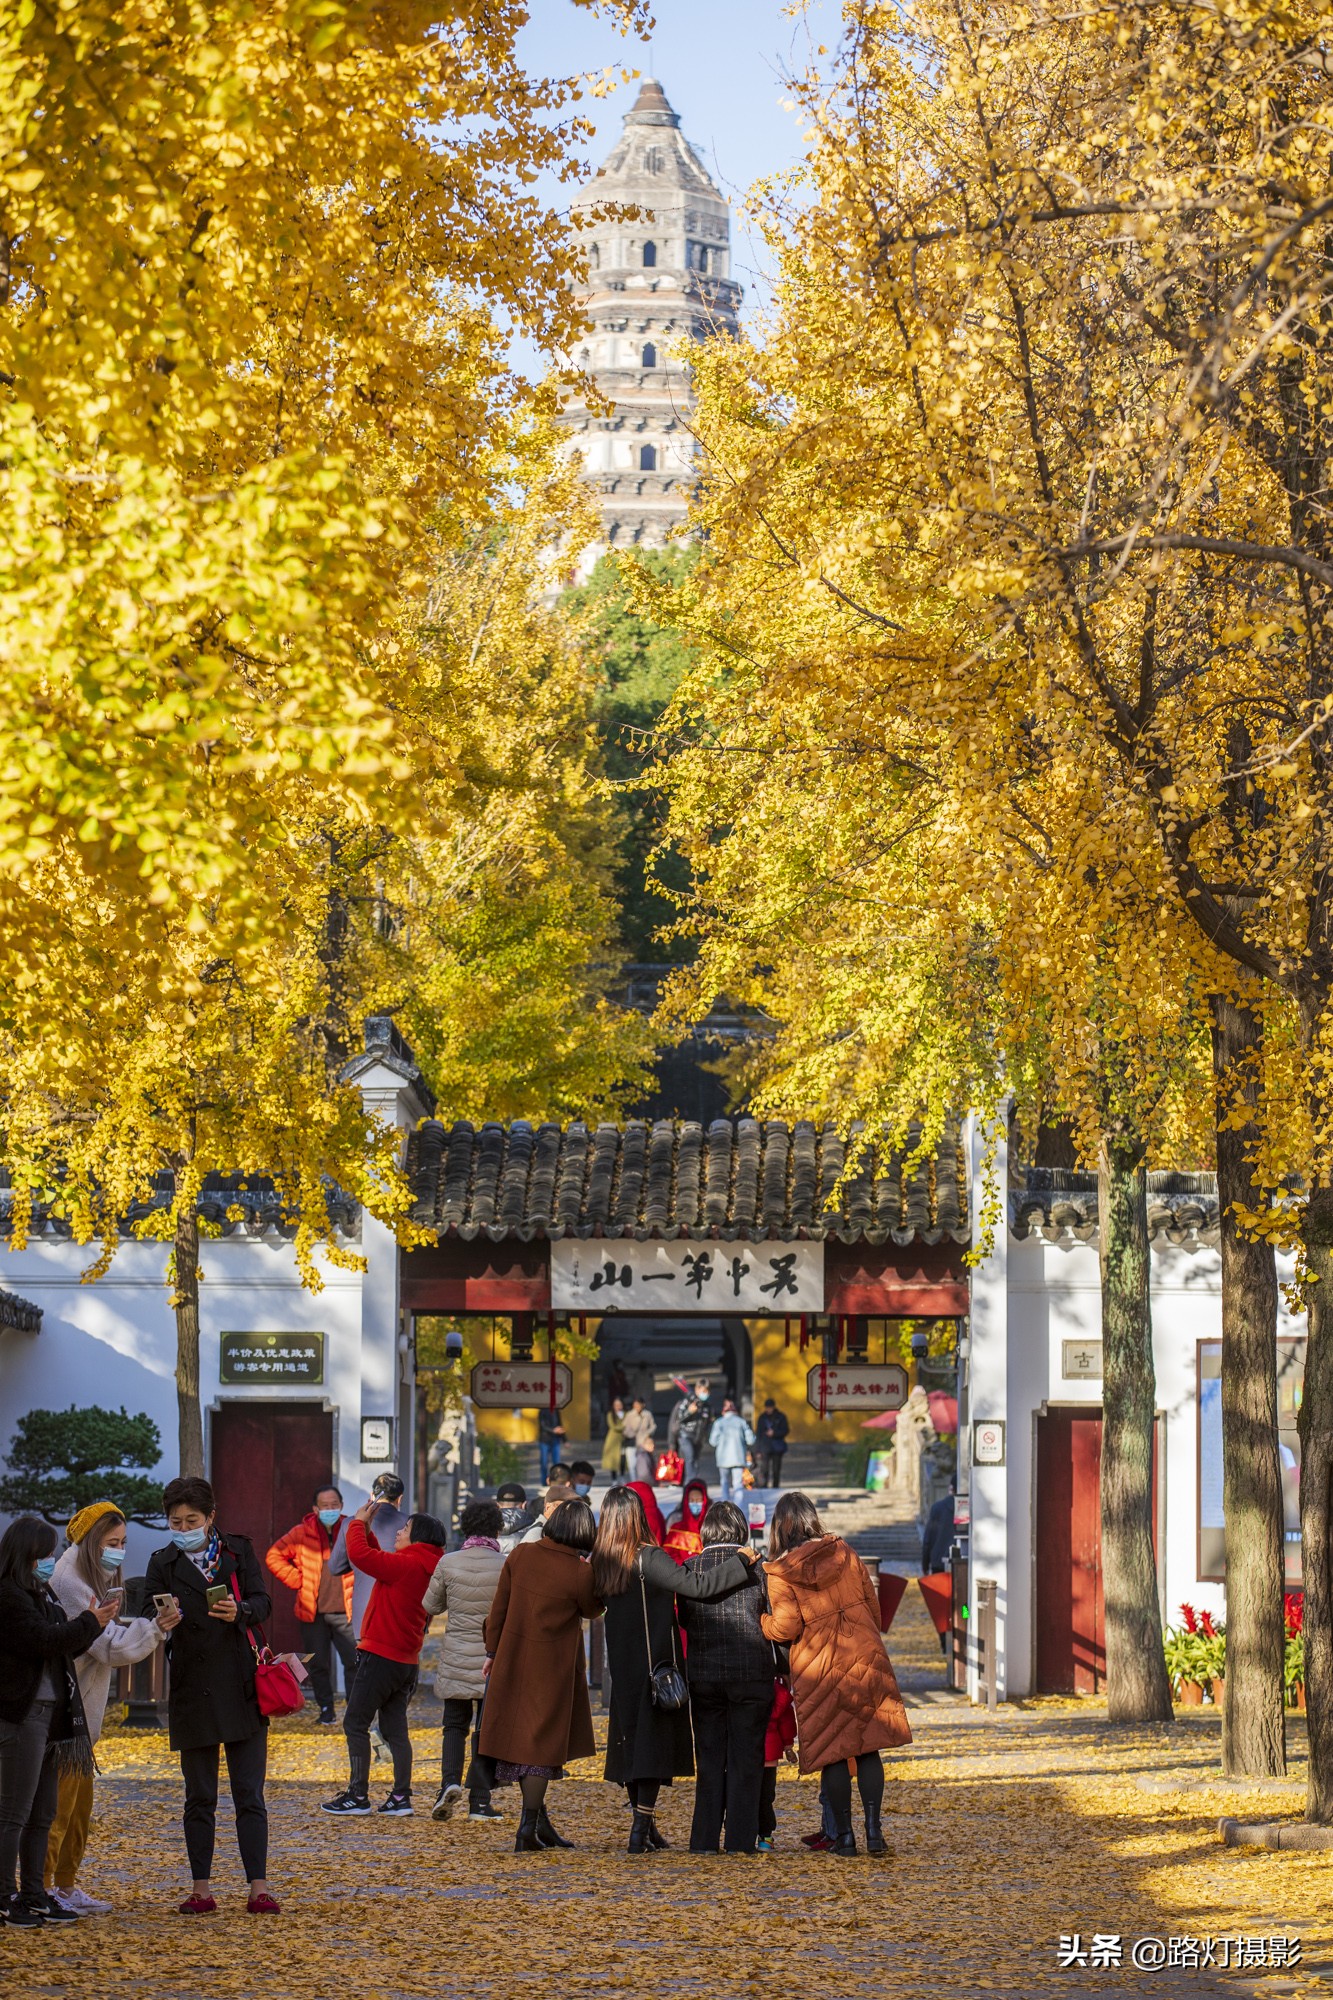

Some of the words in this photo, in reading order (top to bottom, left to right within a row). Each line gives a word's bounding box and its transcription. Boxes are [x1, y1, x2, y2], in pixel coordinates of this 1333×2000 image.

[227, 1348, 316, 1358] 半价及优惠政策
[233, 1362, 309, 1372] 游客专用通道
